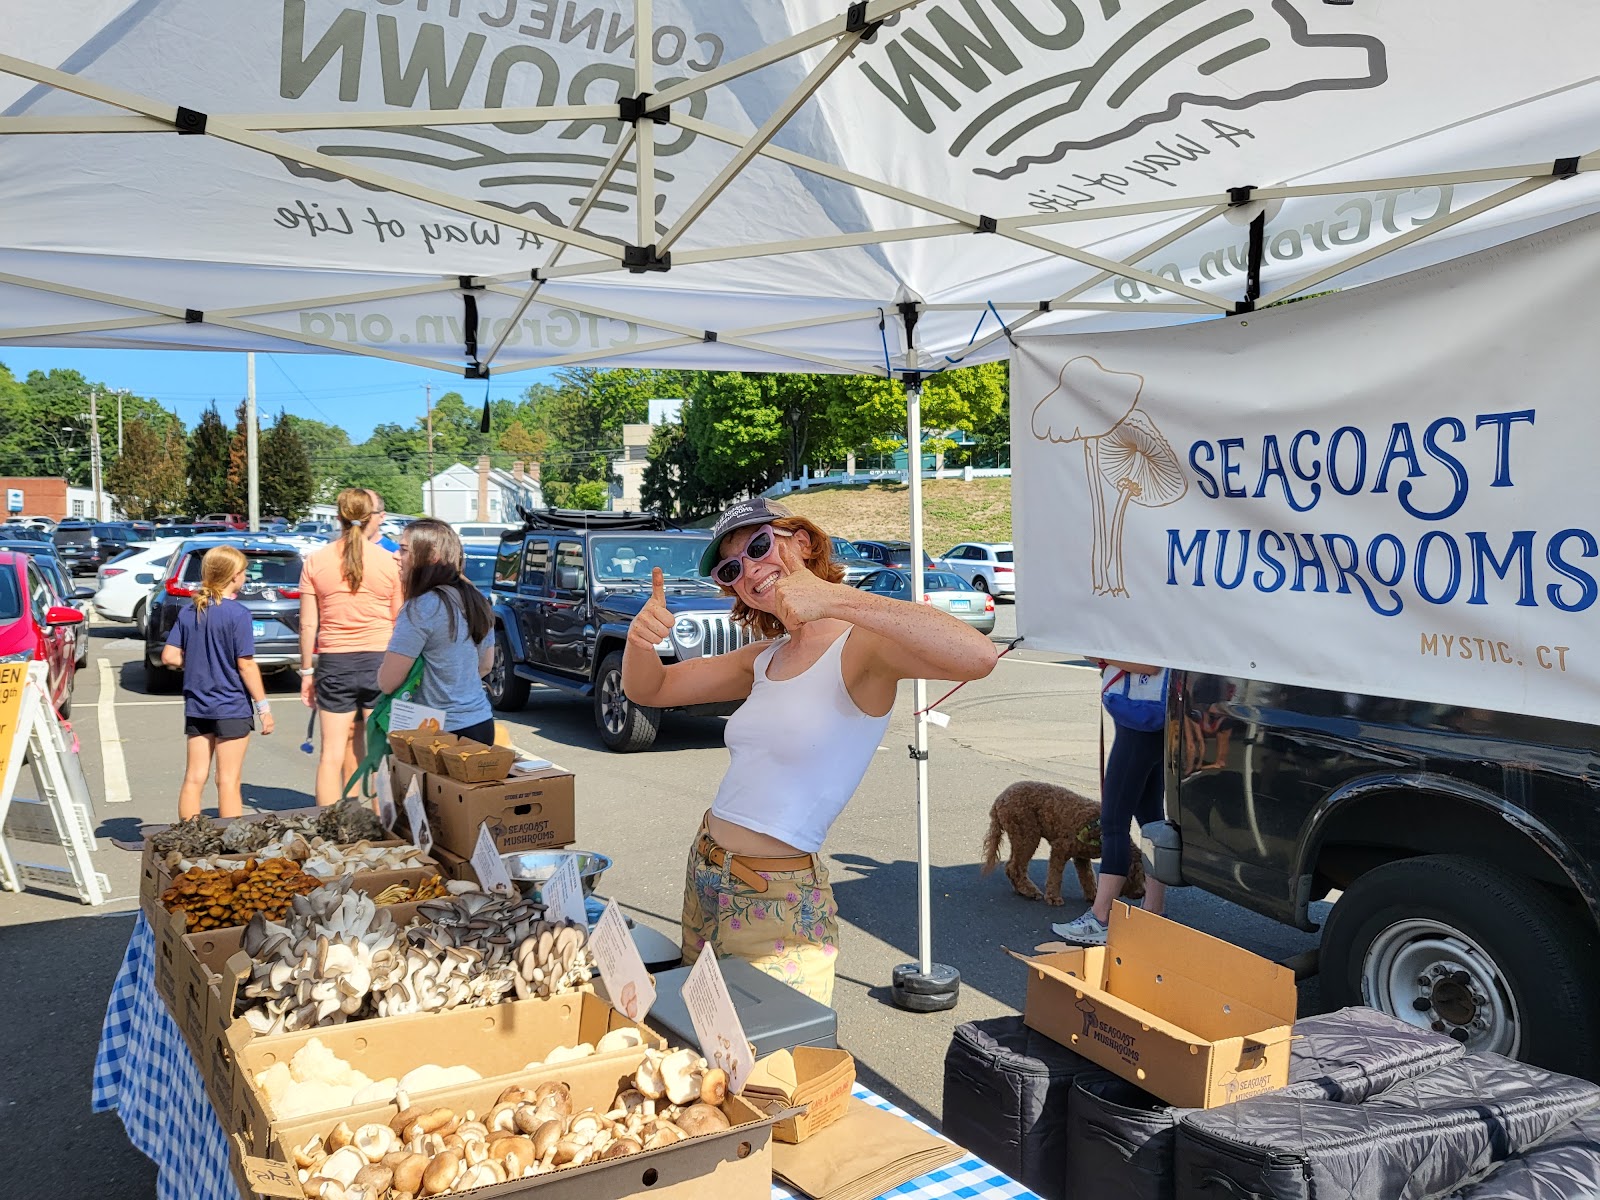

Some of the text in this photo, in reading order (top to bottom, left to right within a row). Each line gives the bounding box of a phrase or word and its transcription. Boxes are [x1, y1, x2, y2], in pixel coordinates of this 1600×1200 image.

[1188, 409, 1535, 520] SEACOAST
[1166, 528, 1599, 616] MUSHROOMS
[1535, 645, 1570, 672] CT
[0, 668, 21, 684] EN
[503, 831, 555, 847] MUSHROOMS
[508, 820, 549, 834] SEACOAST
[1093, 1030, 1140, 1062] MUSHROOMS
[1099, 1021, 1136, 1047] SEACOAST
[1239, 1074, 1272, 1091] SEACOAST
